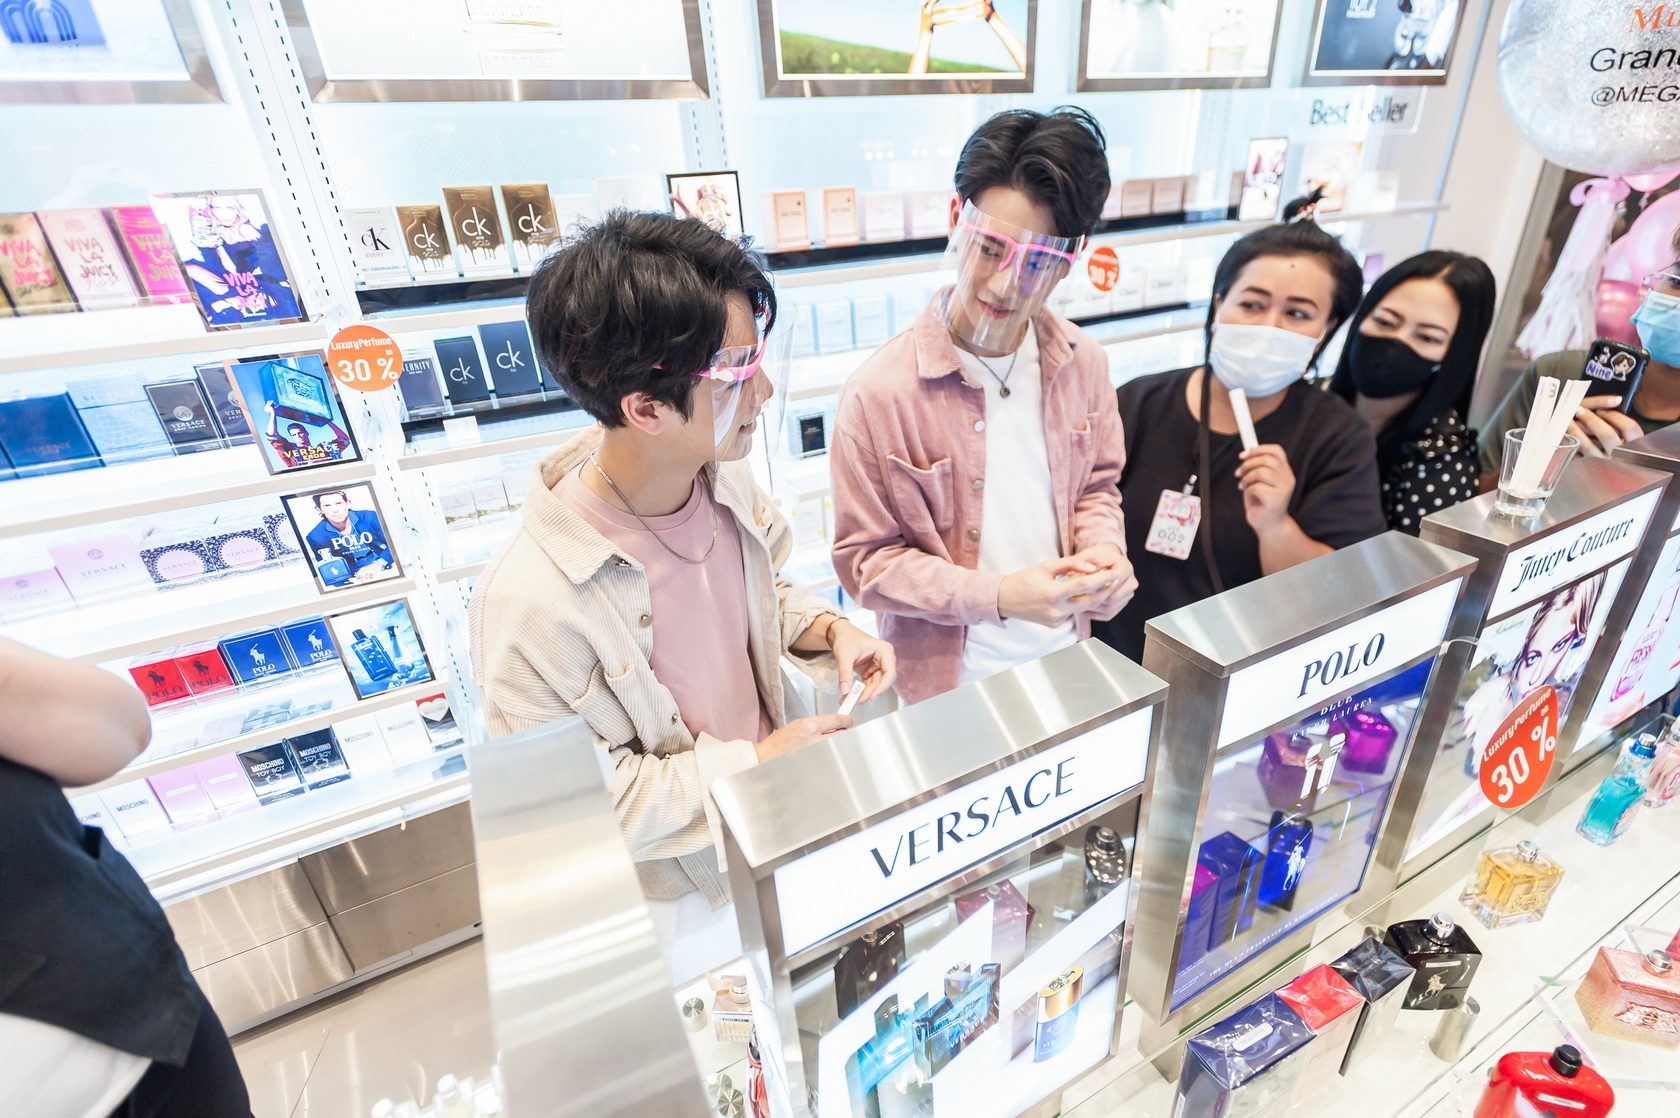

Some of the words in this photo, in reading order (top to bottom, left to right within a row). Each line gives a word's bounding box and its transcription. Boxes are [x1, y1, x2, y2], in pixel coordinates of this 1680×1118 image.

[1590, 48, 1680, 72] Gran
[1310, 99, 1350, 125] Best
[1361, 96, 1408, 123] eller
[462, 206, 491, 237] ck
[518, 204, 547, 233] ck
[413, 223, 440, 249] ck
[0, 240, 42, 257] VIVA
[64, 237, 104, 254] VIVA
[13, 256, 41, 269] LA
[79, 251, 105, 263] LA
[148, 250, 175, 264] LA
[13, 269, 55, 286] JUICY
[80, 264, 117, 279] JUICY
[149, 264, 181, 281] JUIC
[1089, 265, 1105, 285] 30
[223, 272, 259, 287] VIVA
[235, 285, 258, 296] LA
[236, 294, 268, 310] JUICY
[331, 337, 393, 351] LuxuryPerfume
[496, 340, 525, 370] ck
[337, 359, 371, 383] 30
[376, 357, 399, 380] %
[402, 361, 430, 372] TERNITY
[450, 357, 475, 382] ck
[1588, 364, 1611, 379] Nine
[1548, 383, 1557, 398] 3
[170, 419, 206, 429] VERSACE
[284, 443, 340, 458] VERSACE
[331, 531, 373, 550] POLO
[226, 547, 259, 558] VERSACE
[1511, 548, 1566, 593] Juicy
[1566, 518, 1634, 562] Couture
[81, 563, 126, 577] VERSACE
[162, 560, 197, 571] VERSACE
[310, 649, 332, 660] POLO
[252, 663, 275, 674] POLO
[1296, 632, 1386, 699] POLO
[192, 675, 227, 690] POLO
[146, 685, 184, 701] POLO
[1483, 688, 1552, 763] LuxuryPerfume
[344, 730, 375, 743] MOSCHINO
[299, 743, 332, 757] MOSCHINO
[319, 750, 331, 758] BOY
[250, 757, 285, 773] MOSCHINO
[1491, 746, 1529, 804] 30
[1531, 716, 1556, 762] %
[256, 770, 269, 778] TOY
[272, 765, 285, 774] BOY
[116, 798, 149, 813] MOSCHINO
[81, 811, 101, 823] CHINO
[870, 756, 1076, 879] VERSACE
